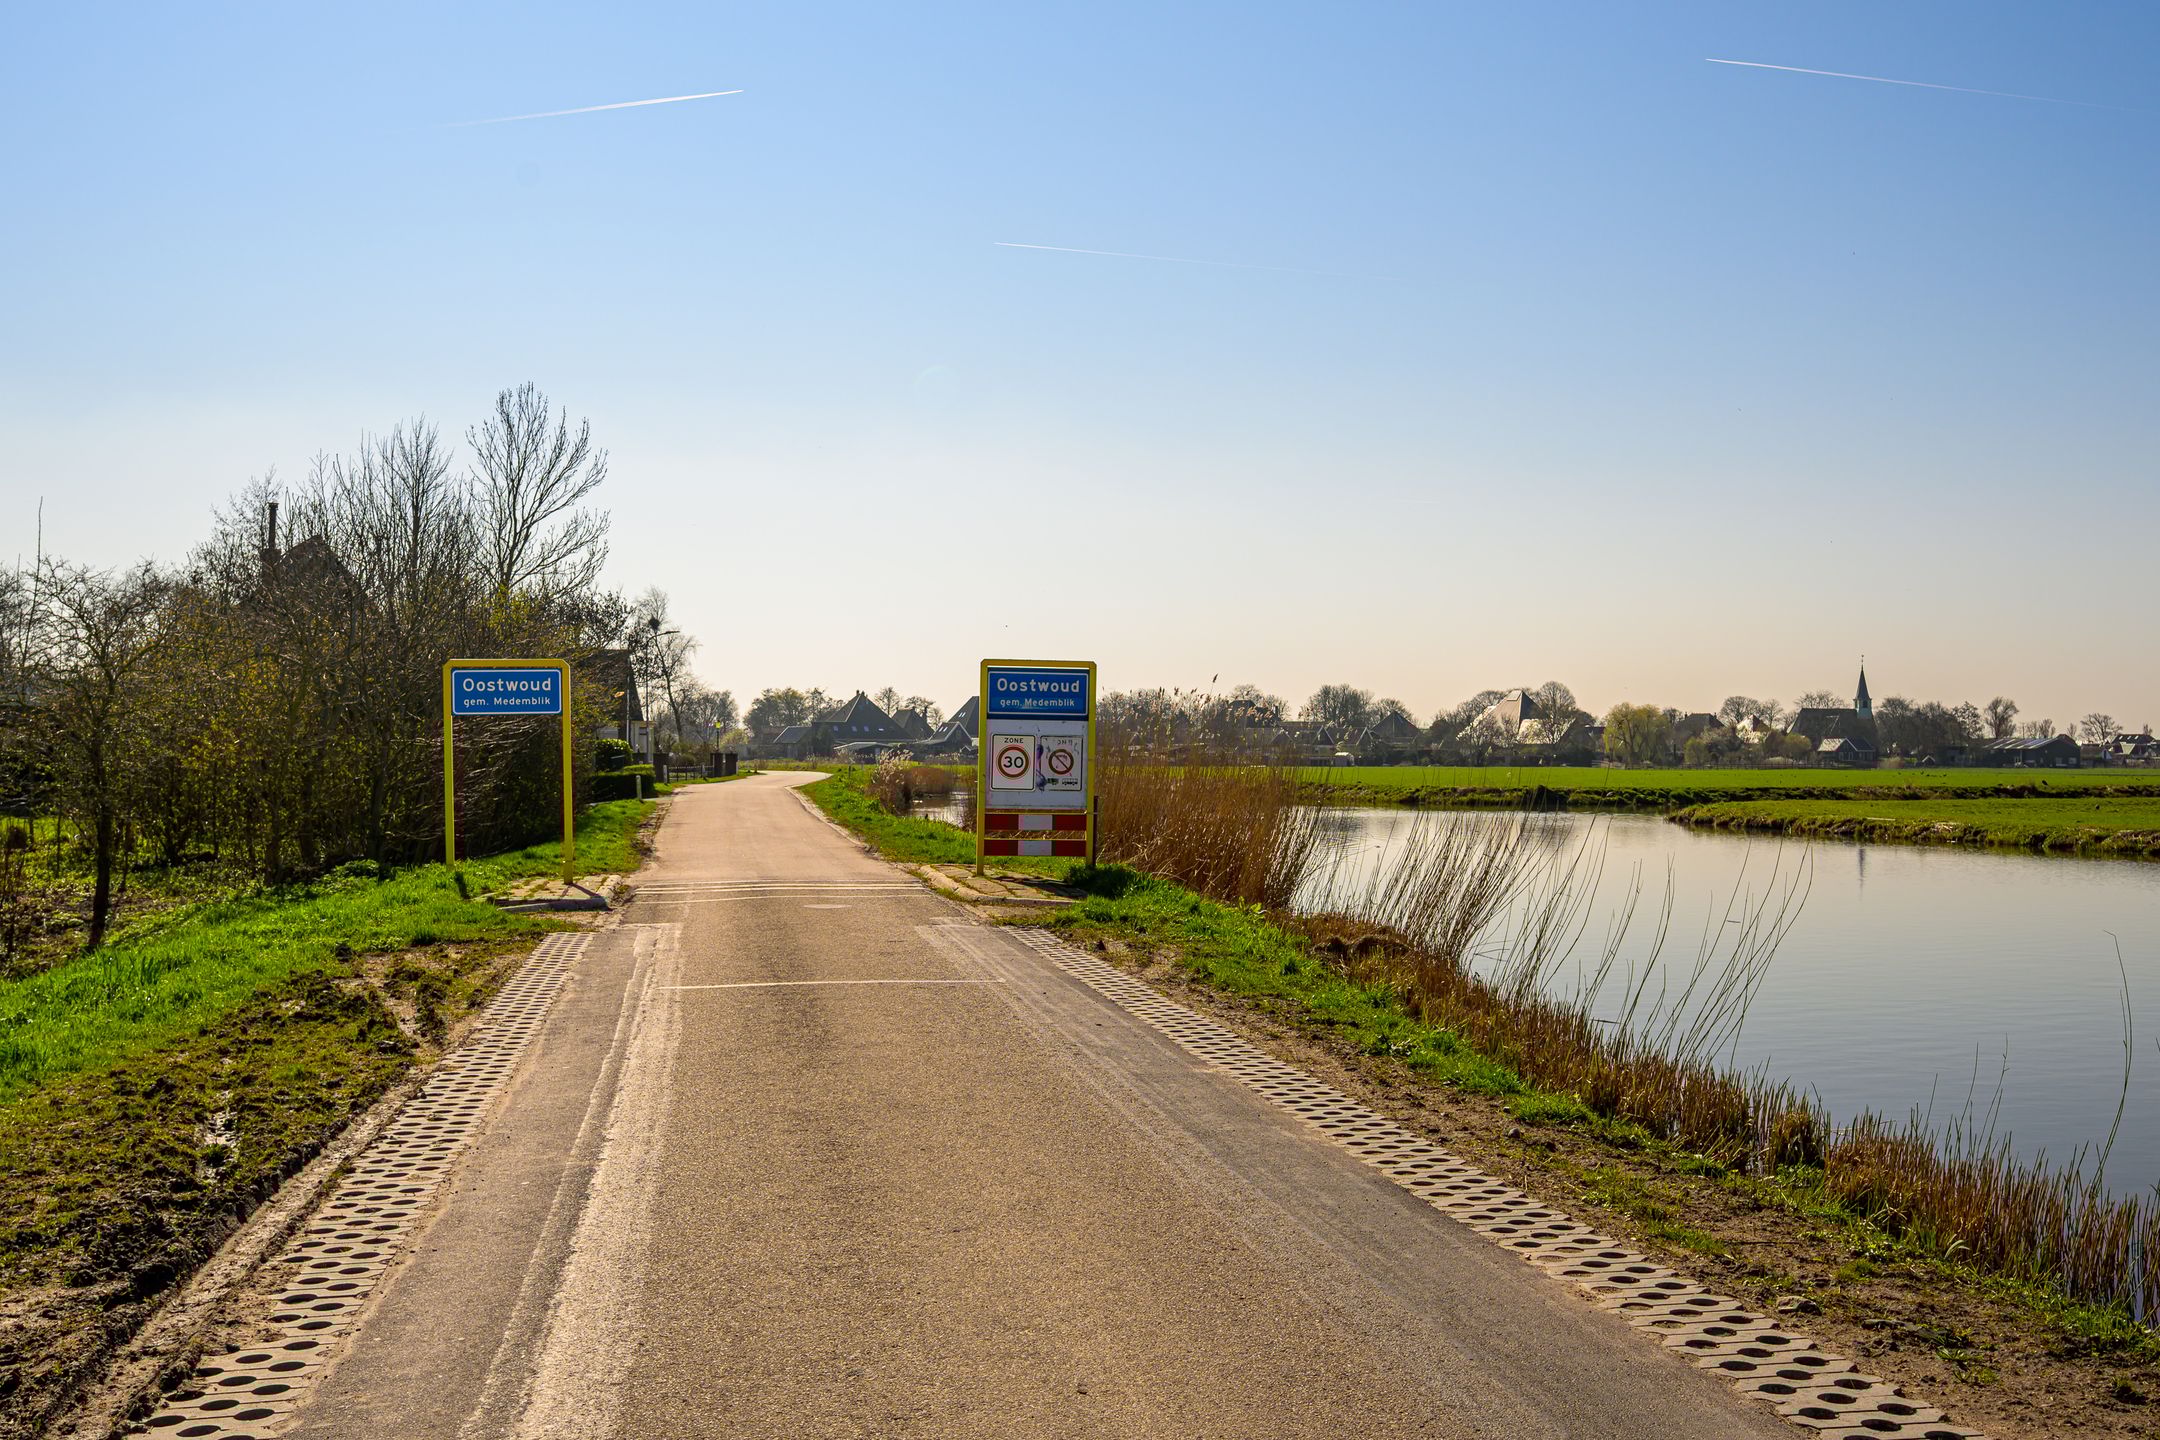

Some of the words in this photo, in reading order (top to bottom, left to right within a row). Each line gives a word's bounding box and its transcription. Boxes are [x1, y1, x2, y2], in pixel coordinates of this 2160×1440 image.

[463, 678, 551, 691] Oostwoud
[997, 678, 1079, 692] Oostwoud
[464, 698, 489, 708] gem.
[494, 697, 550, 705] Medemblik
[1000, 699, 1023, 707] gem.
[1025, 698, 1074, 706] Medemblik
[1003, 756, 1024, 768] 30
